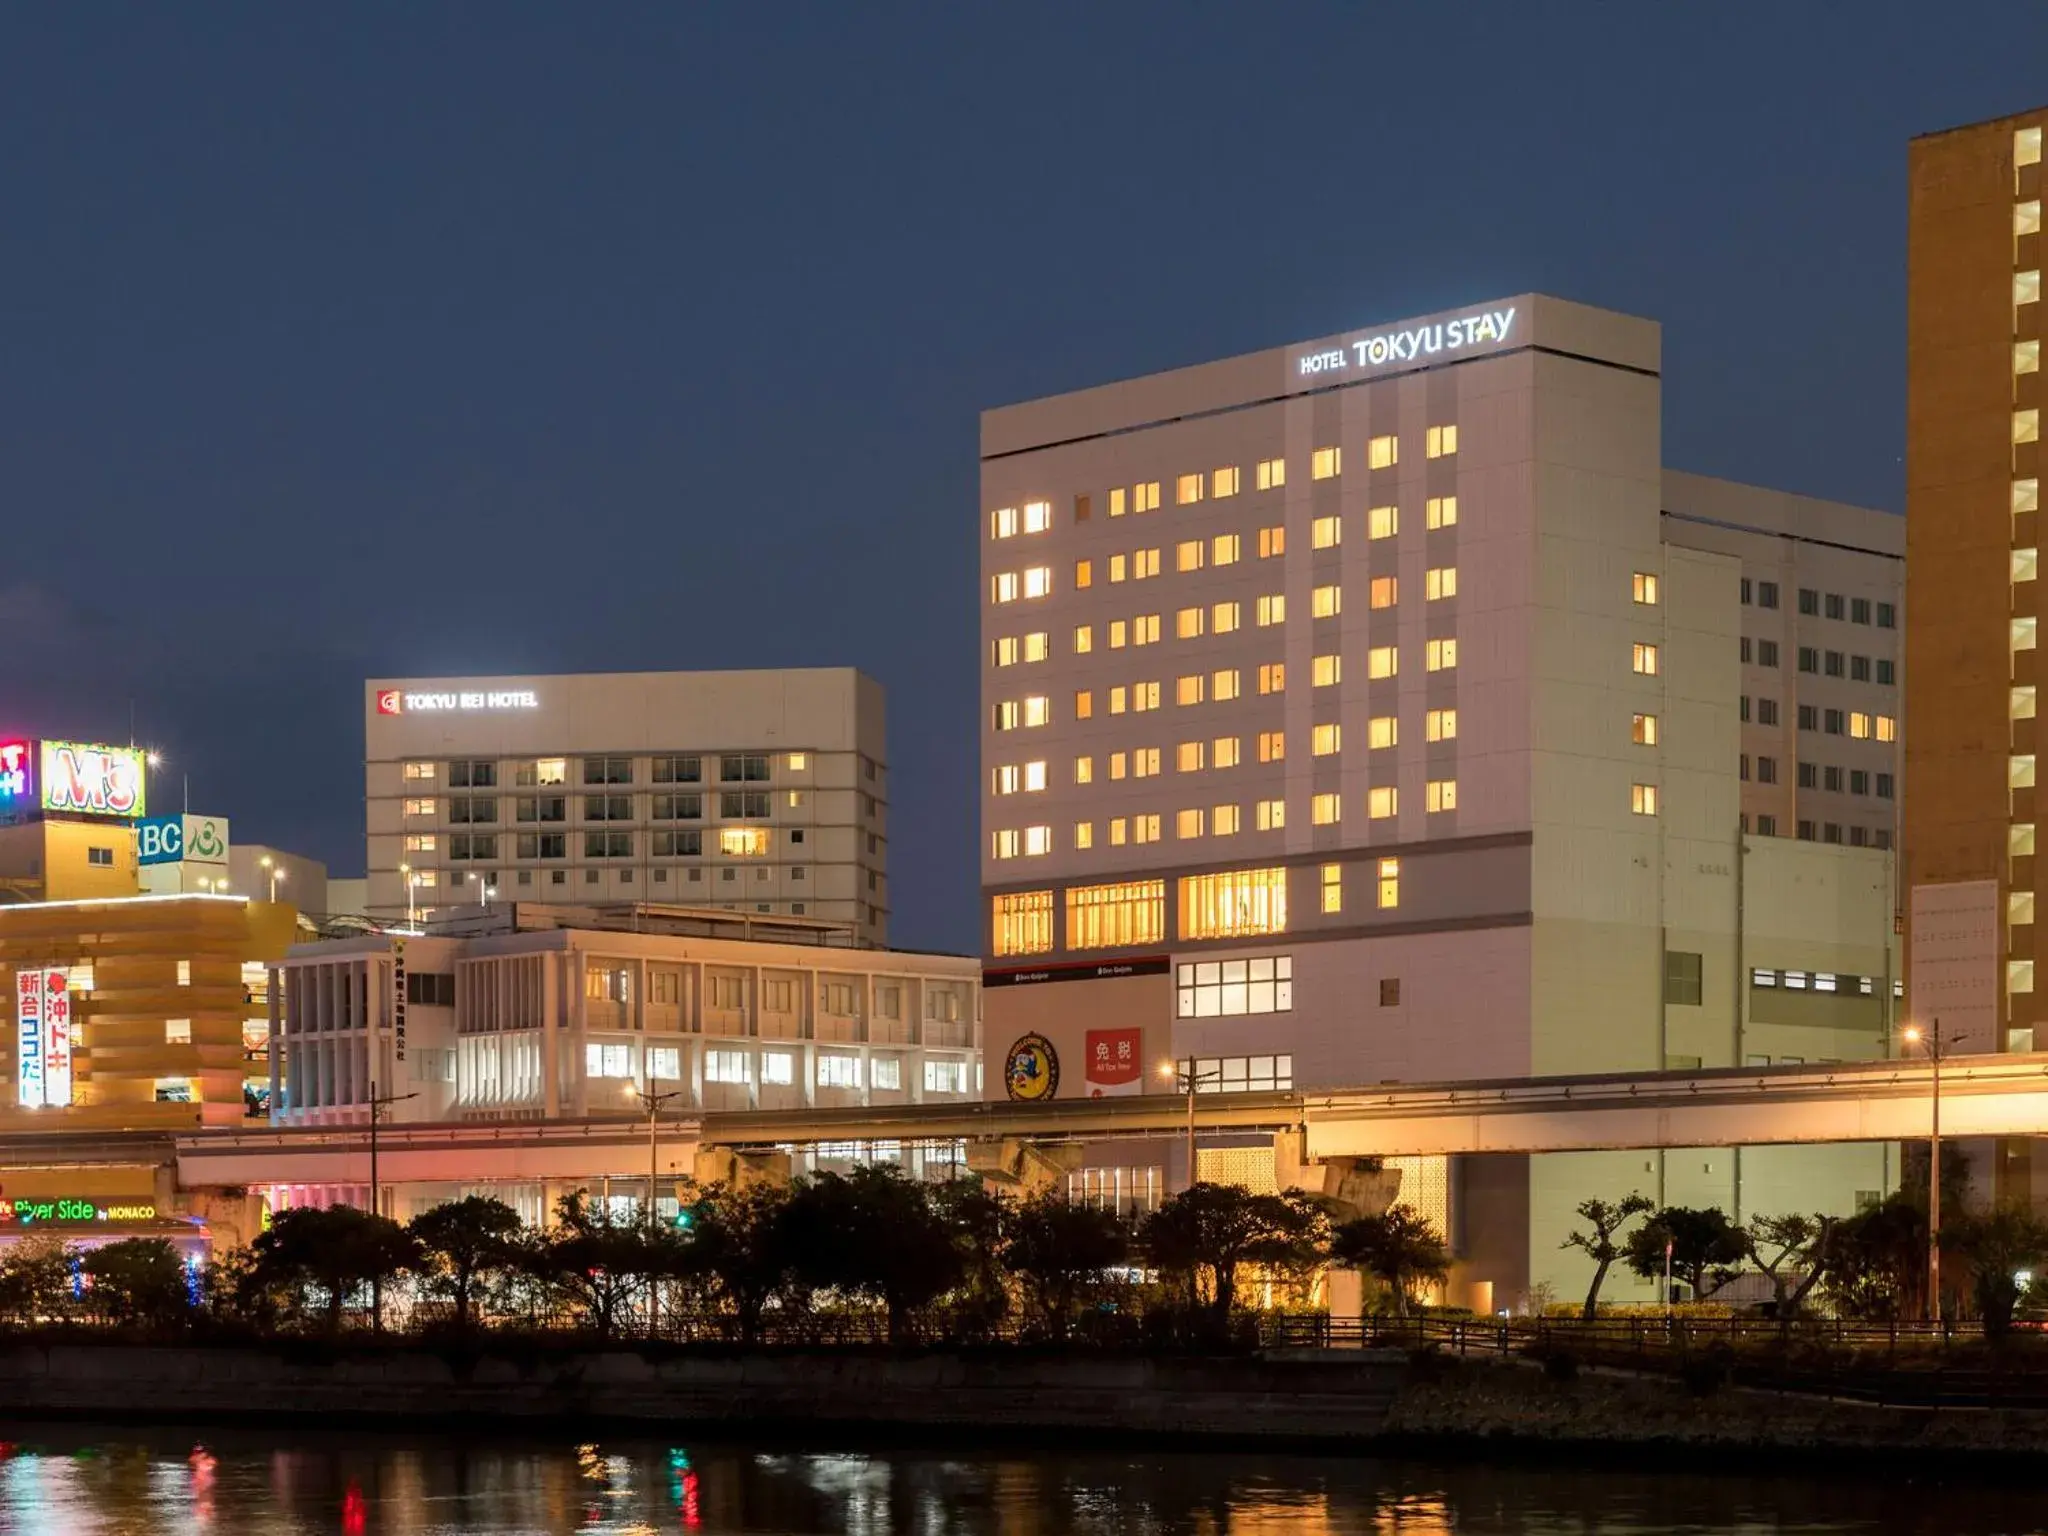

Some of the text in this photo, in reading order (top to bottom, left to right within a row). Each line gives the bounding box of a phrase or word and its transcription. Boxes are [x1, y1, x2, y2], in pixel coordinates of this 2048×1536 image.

[1300, 307, 1515, 375] HOTEL TOKYU STAY
[405, 691, 539, 710] TOKYU REI HOTEL
[1096, 1040, 1131, 1060] 免税
[58, 1200, 94, 1219] Side
[108, 1206, 155, 1219] MONACO
